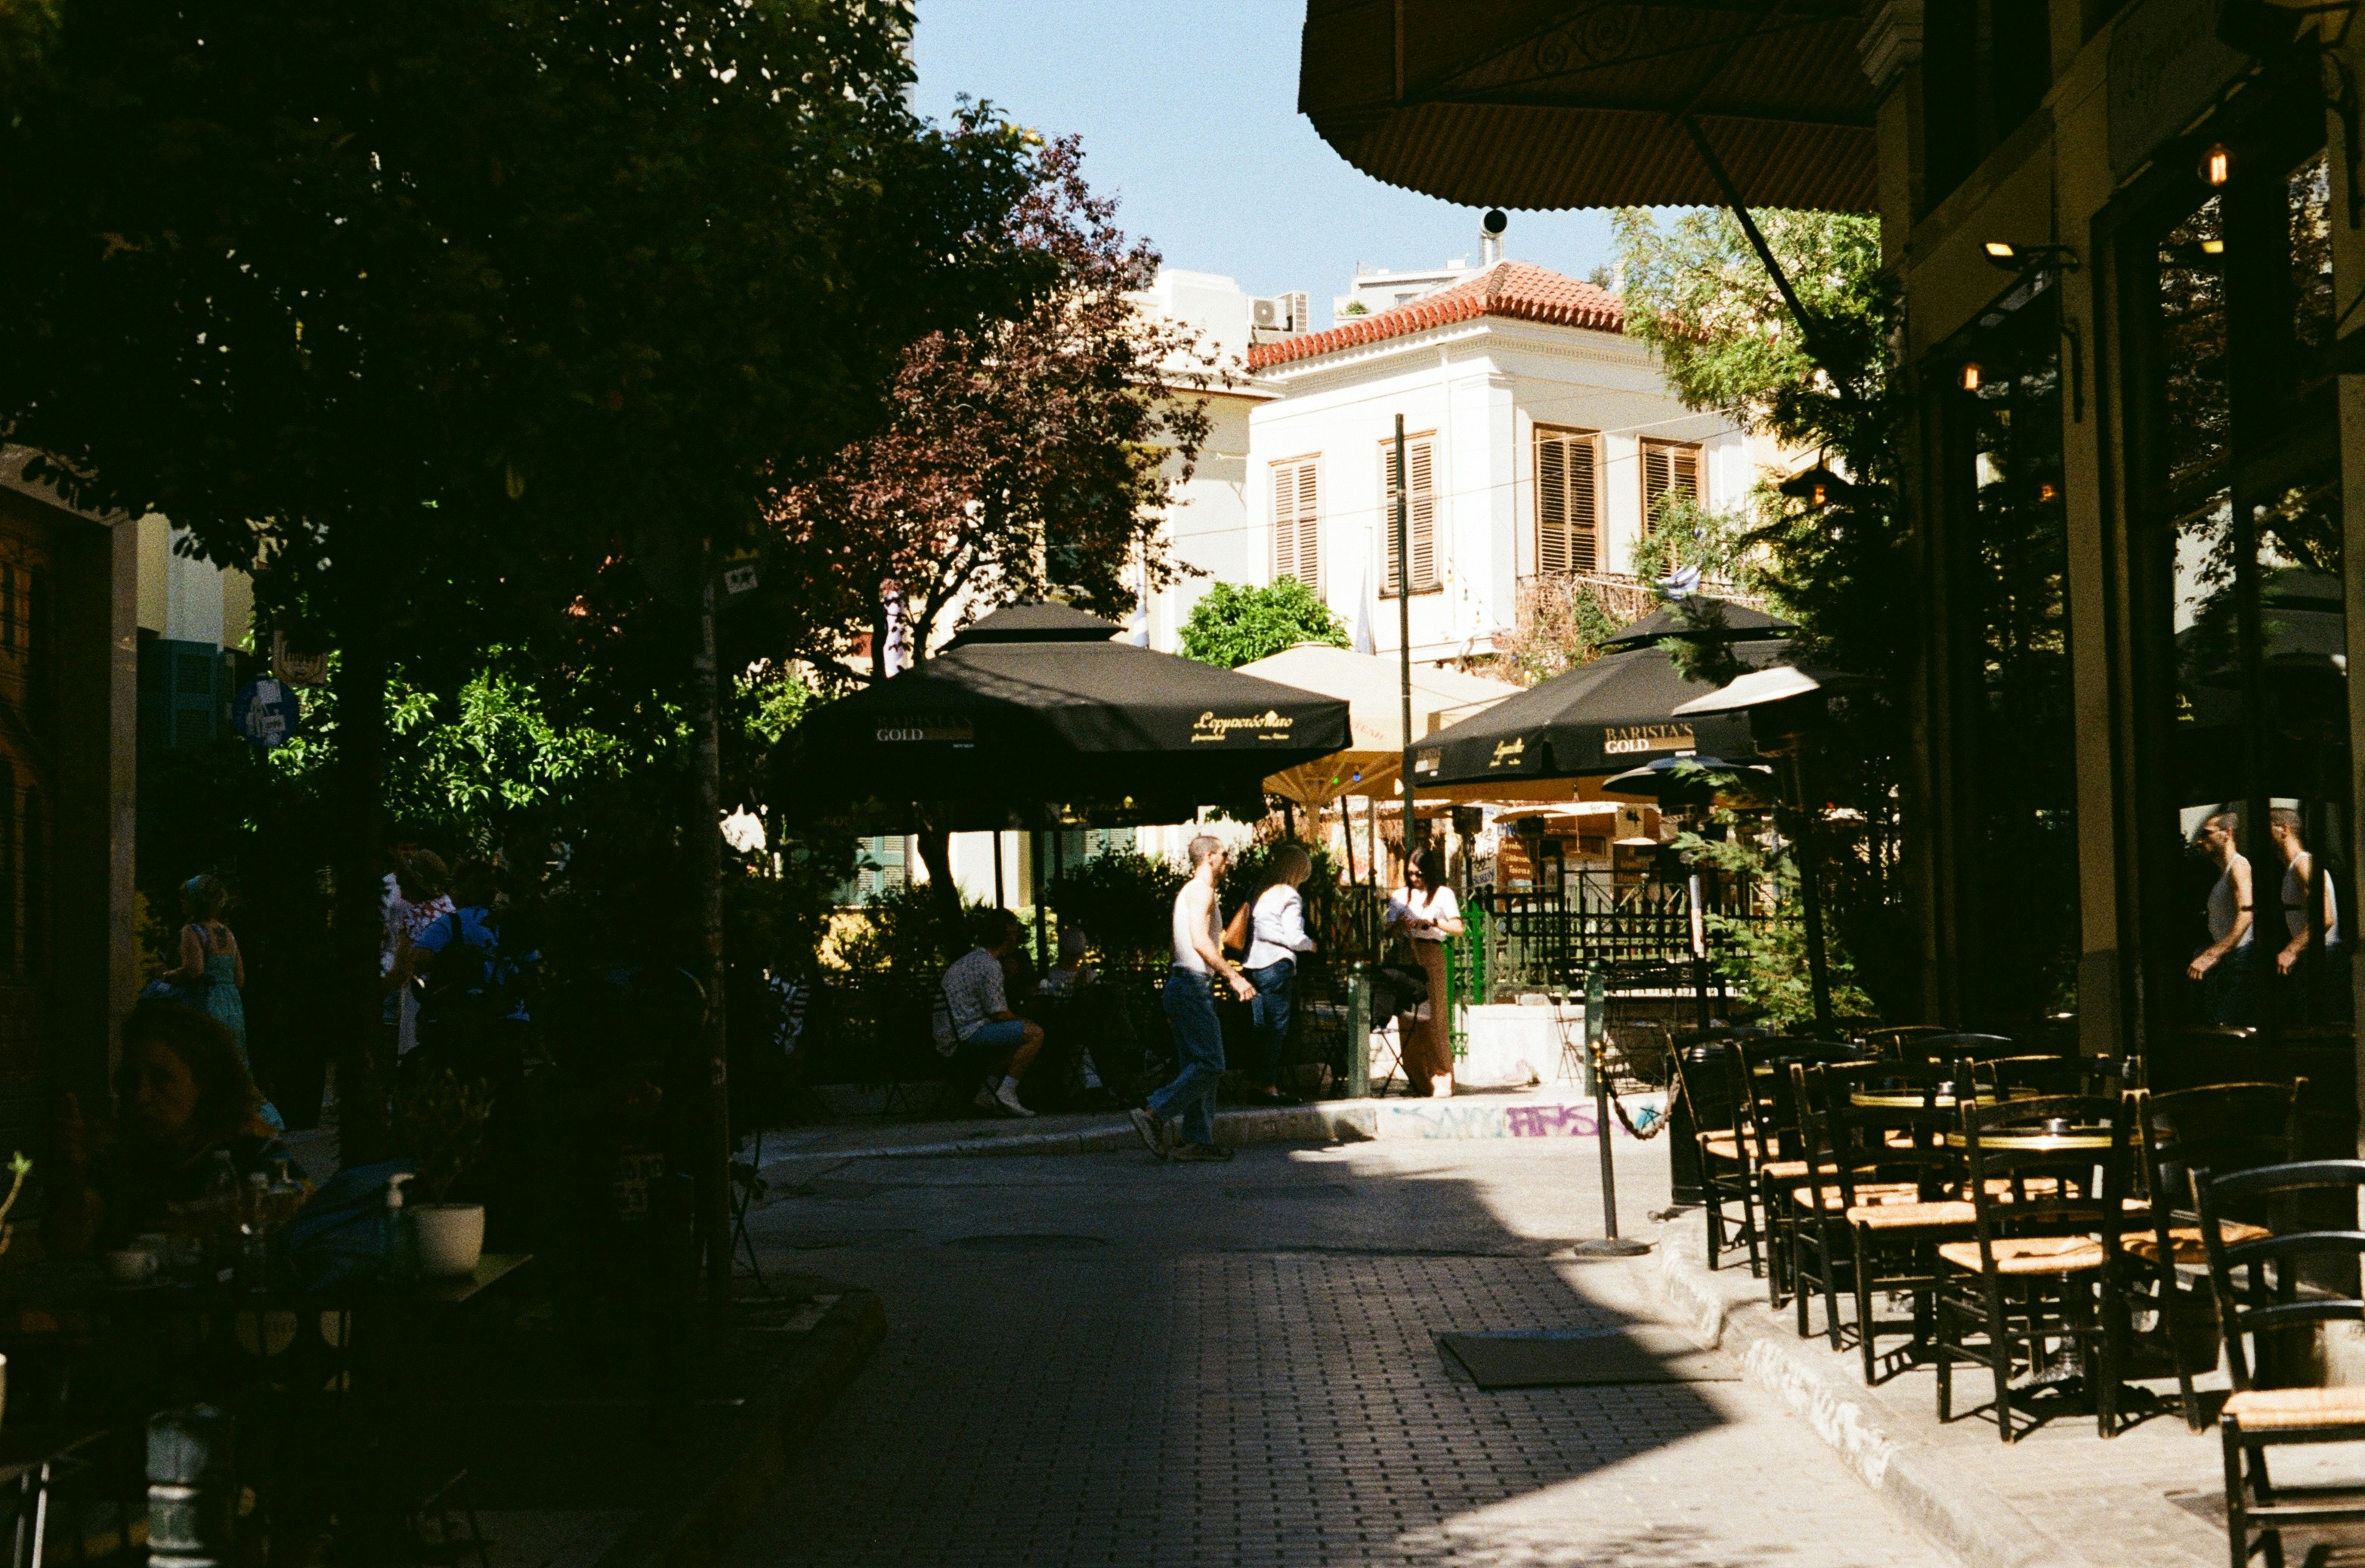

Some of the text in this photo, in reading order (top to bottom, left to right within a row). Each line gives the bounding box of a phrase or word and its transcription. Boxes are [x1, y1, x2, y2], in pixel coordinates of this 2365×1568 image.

[876, 728, 923, 741] GOLD
[1605, 723, 1693, 741] BARISTA'S
[1606, 738, 1649, 753] GOLD
